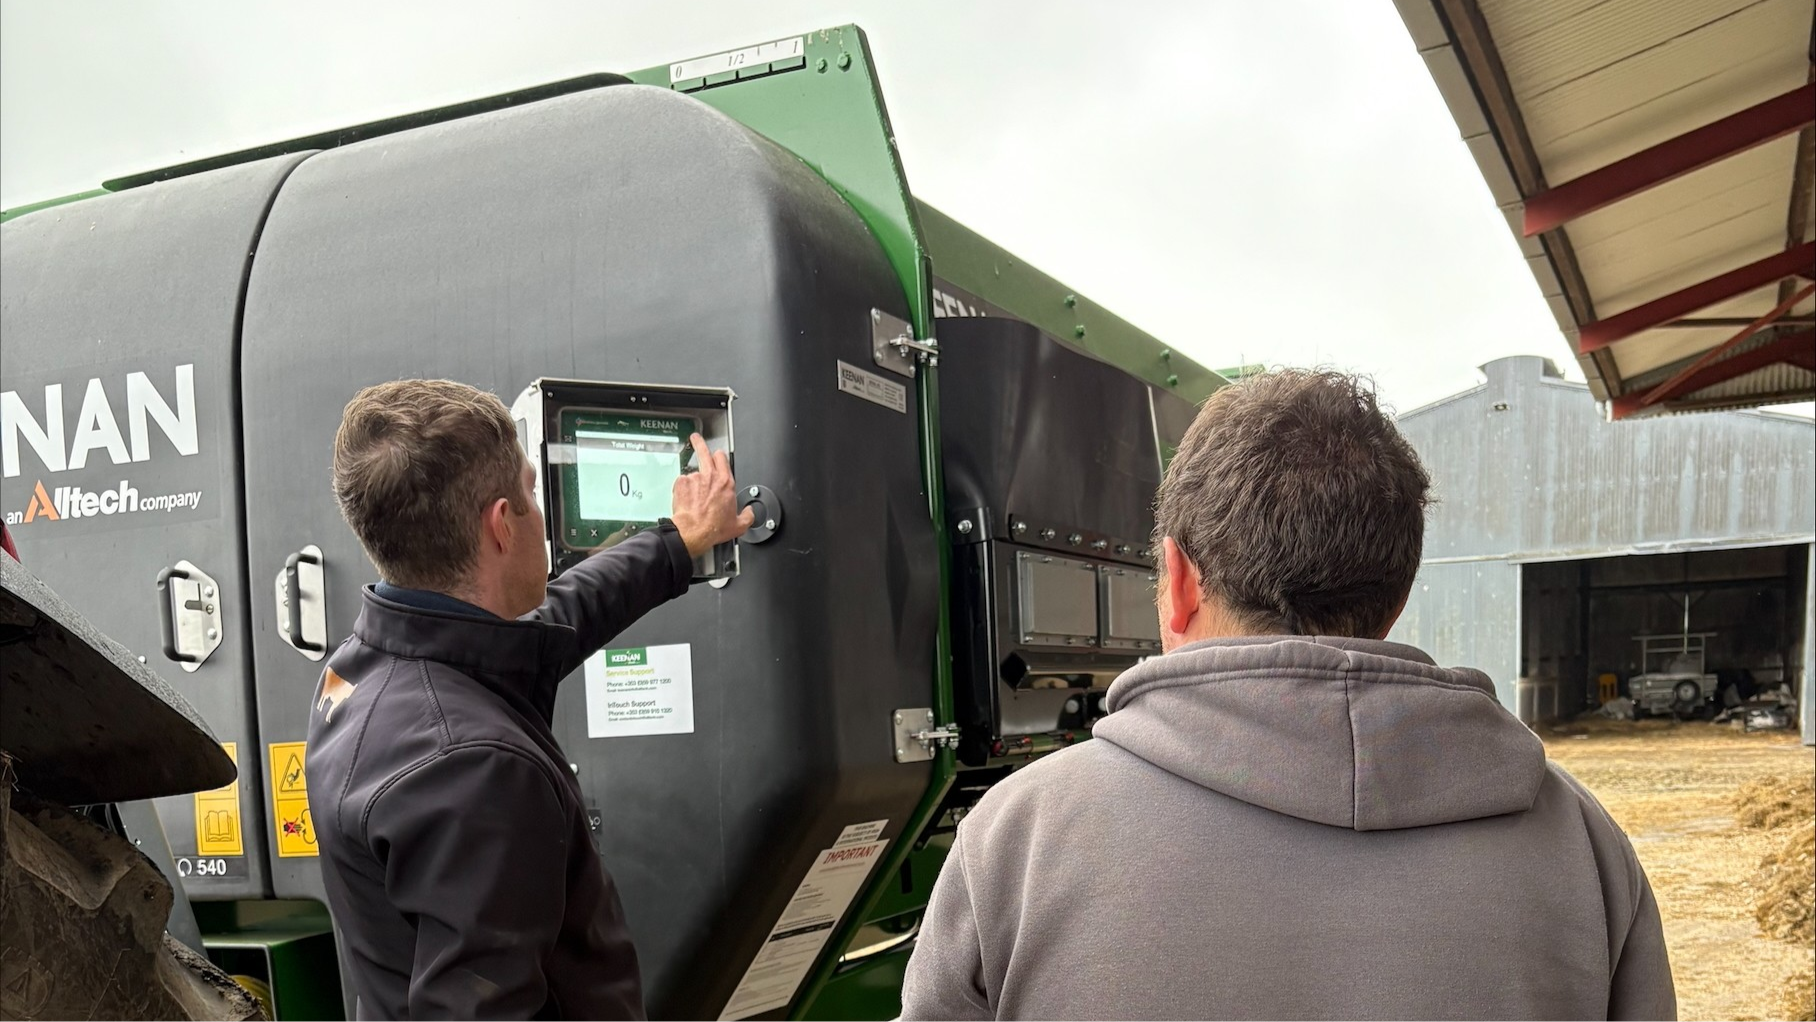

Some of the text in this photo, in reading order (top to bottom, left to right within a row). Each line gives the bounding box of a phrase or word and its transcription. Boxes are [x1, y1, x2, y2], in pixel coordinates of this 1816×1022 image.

[675, 65, 683, 78] 0
[728, 53, 745, 67] 1/2
[841, 368, 865, 386] KEENAN
[640, 419, 679, 430] KEENAN
[611, 441, 645, 451] Total Weight
[619, 473, 643, 500] 0 Kg
[6, 479, 202, 525] an Alltech company
[630, 668, 655, 676] Support
[608, 700, 656, 709] InTouch Support
[823, 844, 880, 864] IMPORTANT
[196, 858, 227, 876] 540
